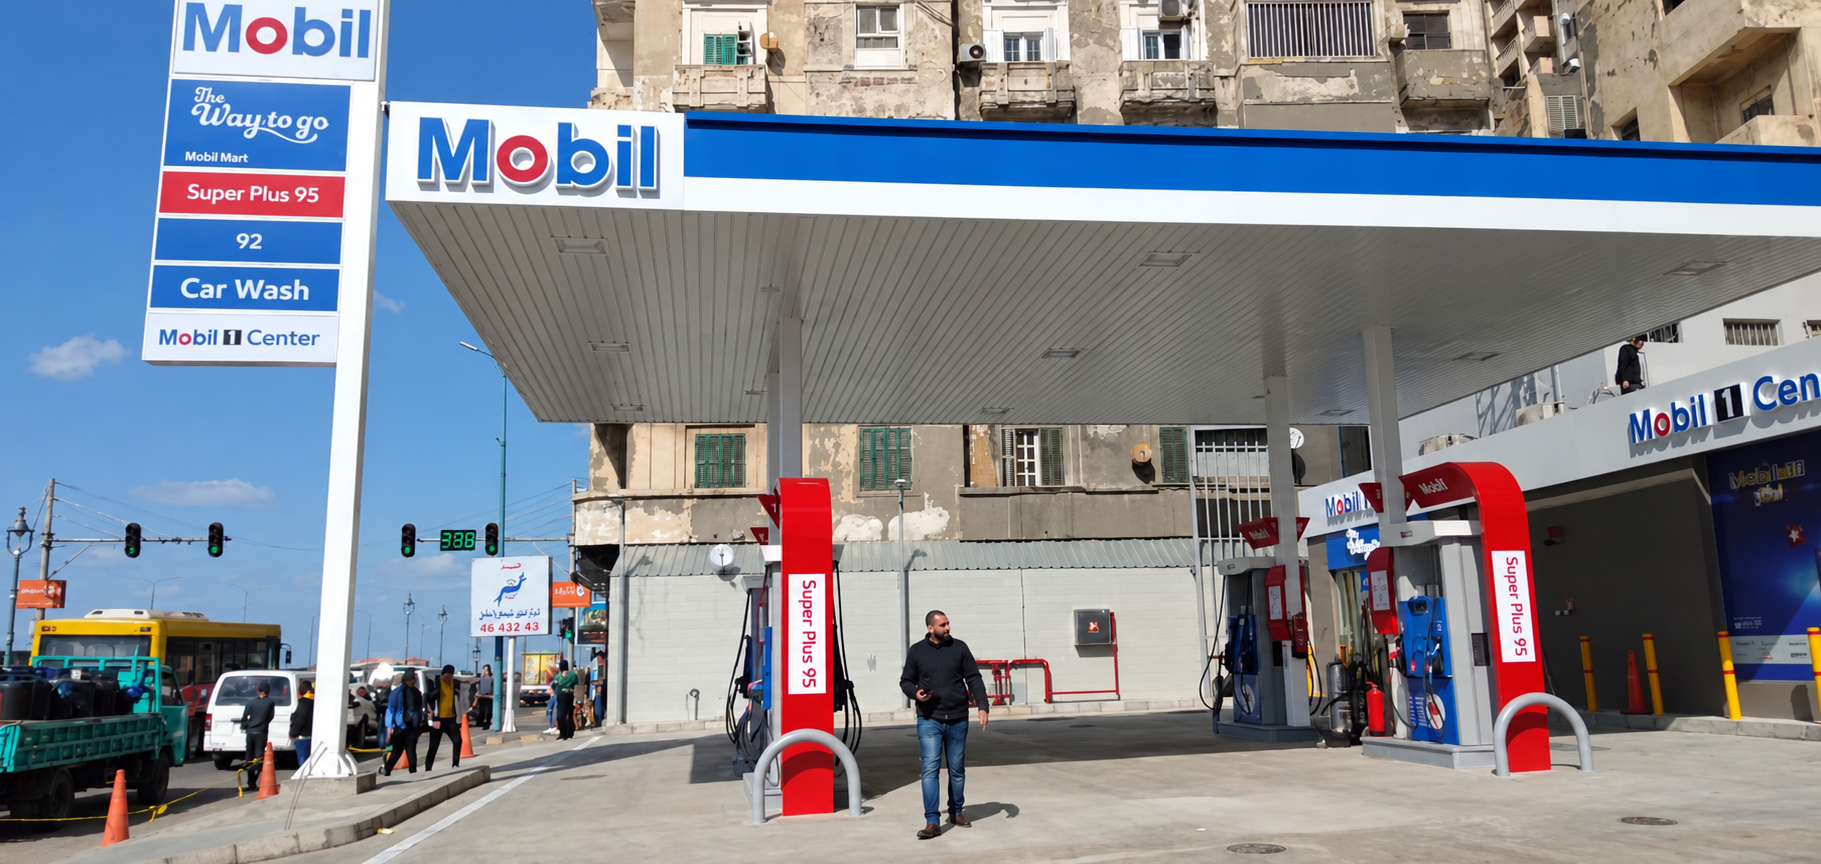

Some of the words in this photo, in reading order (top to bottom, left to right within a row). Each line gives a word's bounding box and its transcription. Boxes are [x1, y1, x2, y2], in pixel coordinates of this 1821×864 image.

[183, 2, 371, 58] Mobil
[194, 86, 226, 104] The
[191, 103, 262, 139] Way
[266, 111, 293, 128] to
[296, 115, 329, 140] go
[185, 151, 218, 163] Mobil
[220, 153, 249, 163] Mart
[415, 117, 658, 189] Mobil
[186, 183, 245, 204] Super
[250, 185, 289, 203] Plus
[294, 187, 320, 204] 95
[236, 233, 263, 249] 92
[180, 277, 227, 299] Car
[234, 279, 309, 300] Wash
[158, 329, 218, 346] Mobil
[224, 330, 239, 345] 1
[246, 329, 320, 346] Center
[1629, 393, 1708, 443] Mobil
[1325, 490, 1359, 517] Mobil
[1503, 557, 1519, 600] Super
[798, 580, 817, 627] Super
[1510, 603, 1524, 634] Plus
[802, 631, 816, 663] Plus
[1514, 638, 1528, 656] 95
[802, 668, 816, 688] 95
